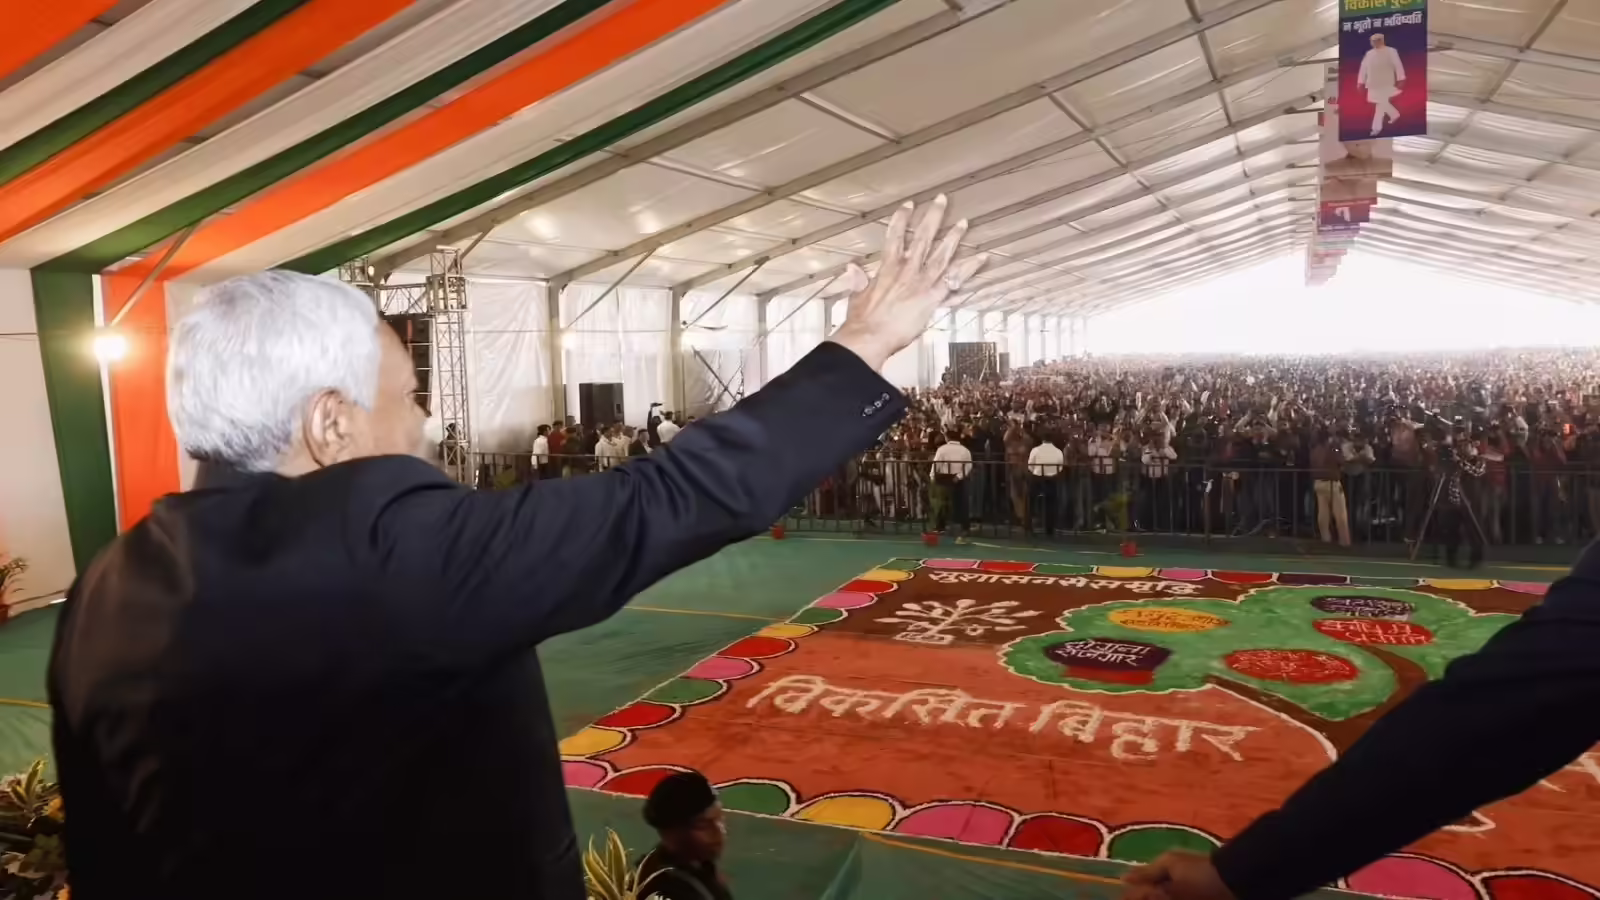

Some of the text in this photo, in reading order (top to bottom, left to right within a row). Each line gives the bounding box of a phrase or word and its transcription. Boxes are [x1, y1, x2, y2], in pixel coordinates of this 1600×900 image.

[1343, 11, 1422, 33] न भूतो न भविष्यति
[746, 675, 1262, 762] विकसित बिहार
